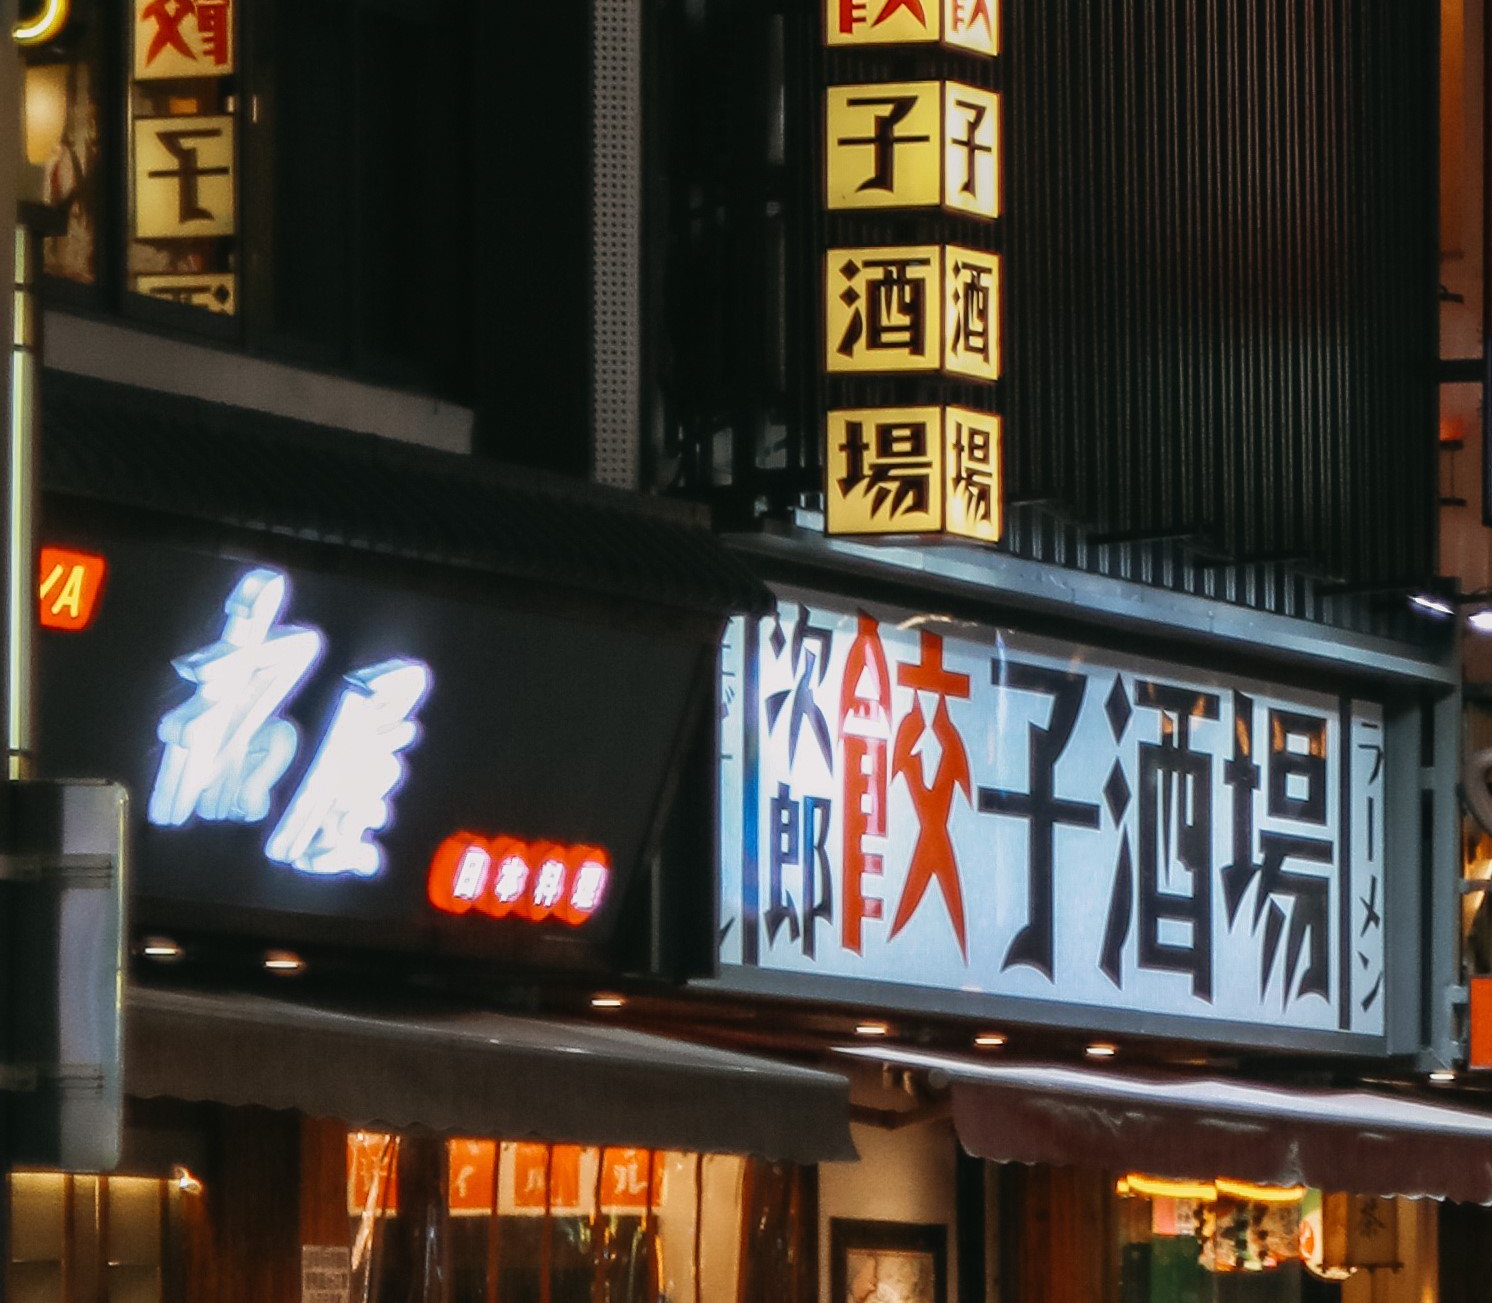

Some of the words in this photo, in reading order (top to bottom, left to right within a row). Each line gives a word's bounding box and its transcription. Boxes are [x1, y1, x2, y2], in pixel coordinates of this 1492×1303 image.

[765, 604, 833, 960] 次郎
[839, 608, 1334, 1014] 餃子酒場
[1357, 720, 1388, 1014] ラーメン
